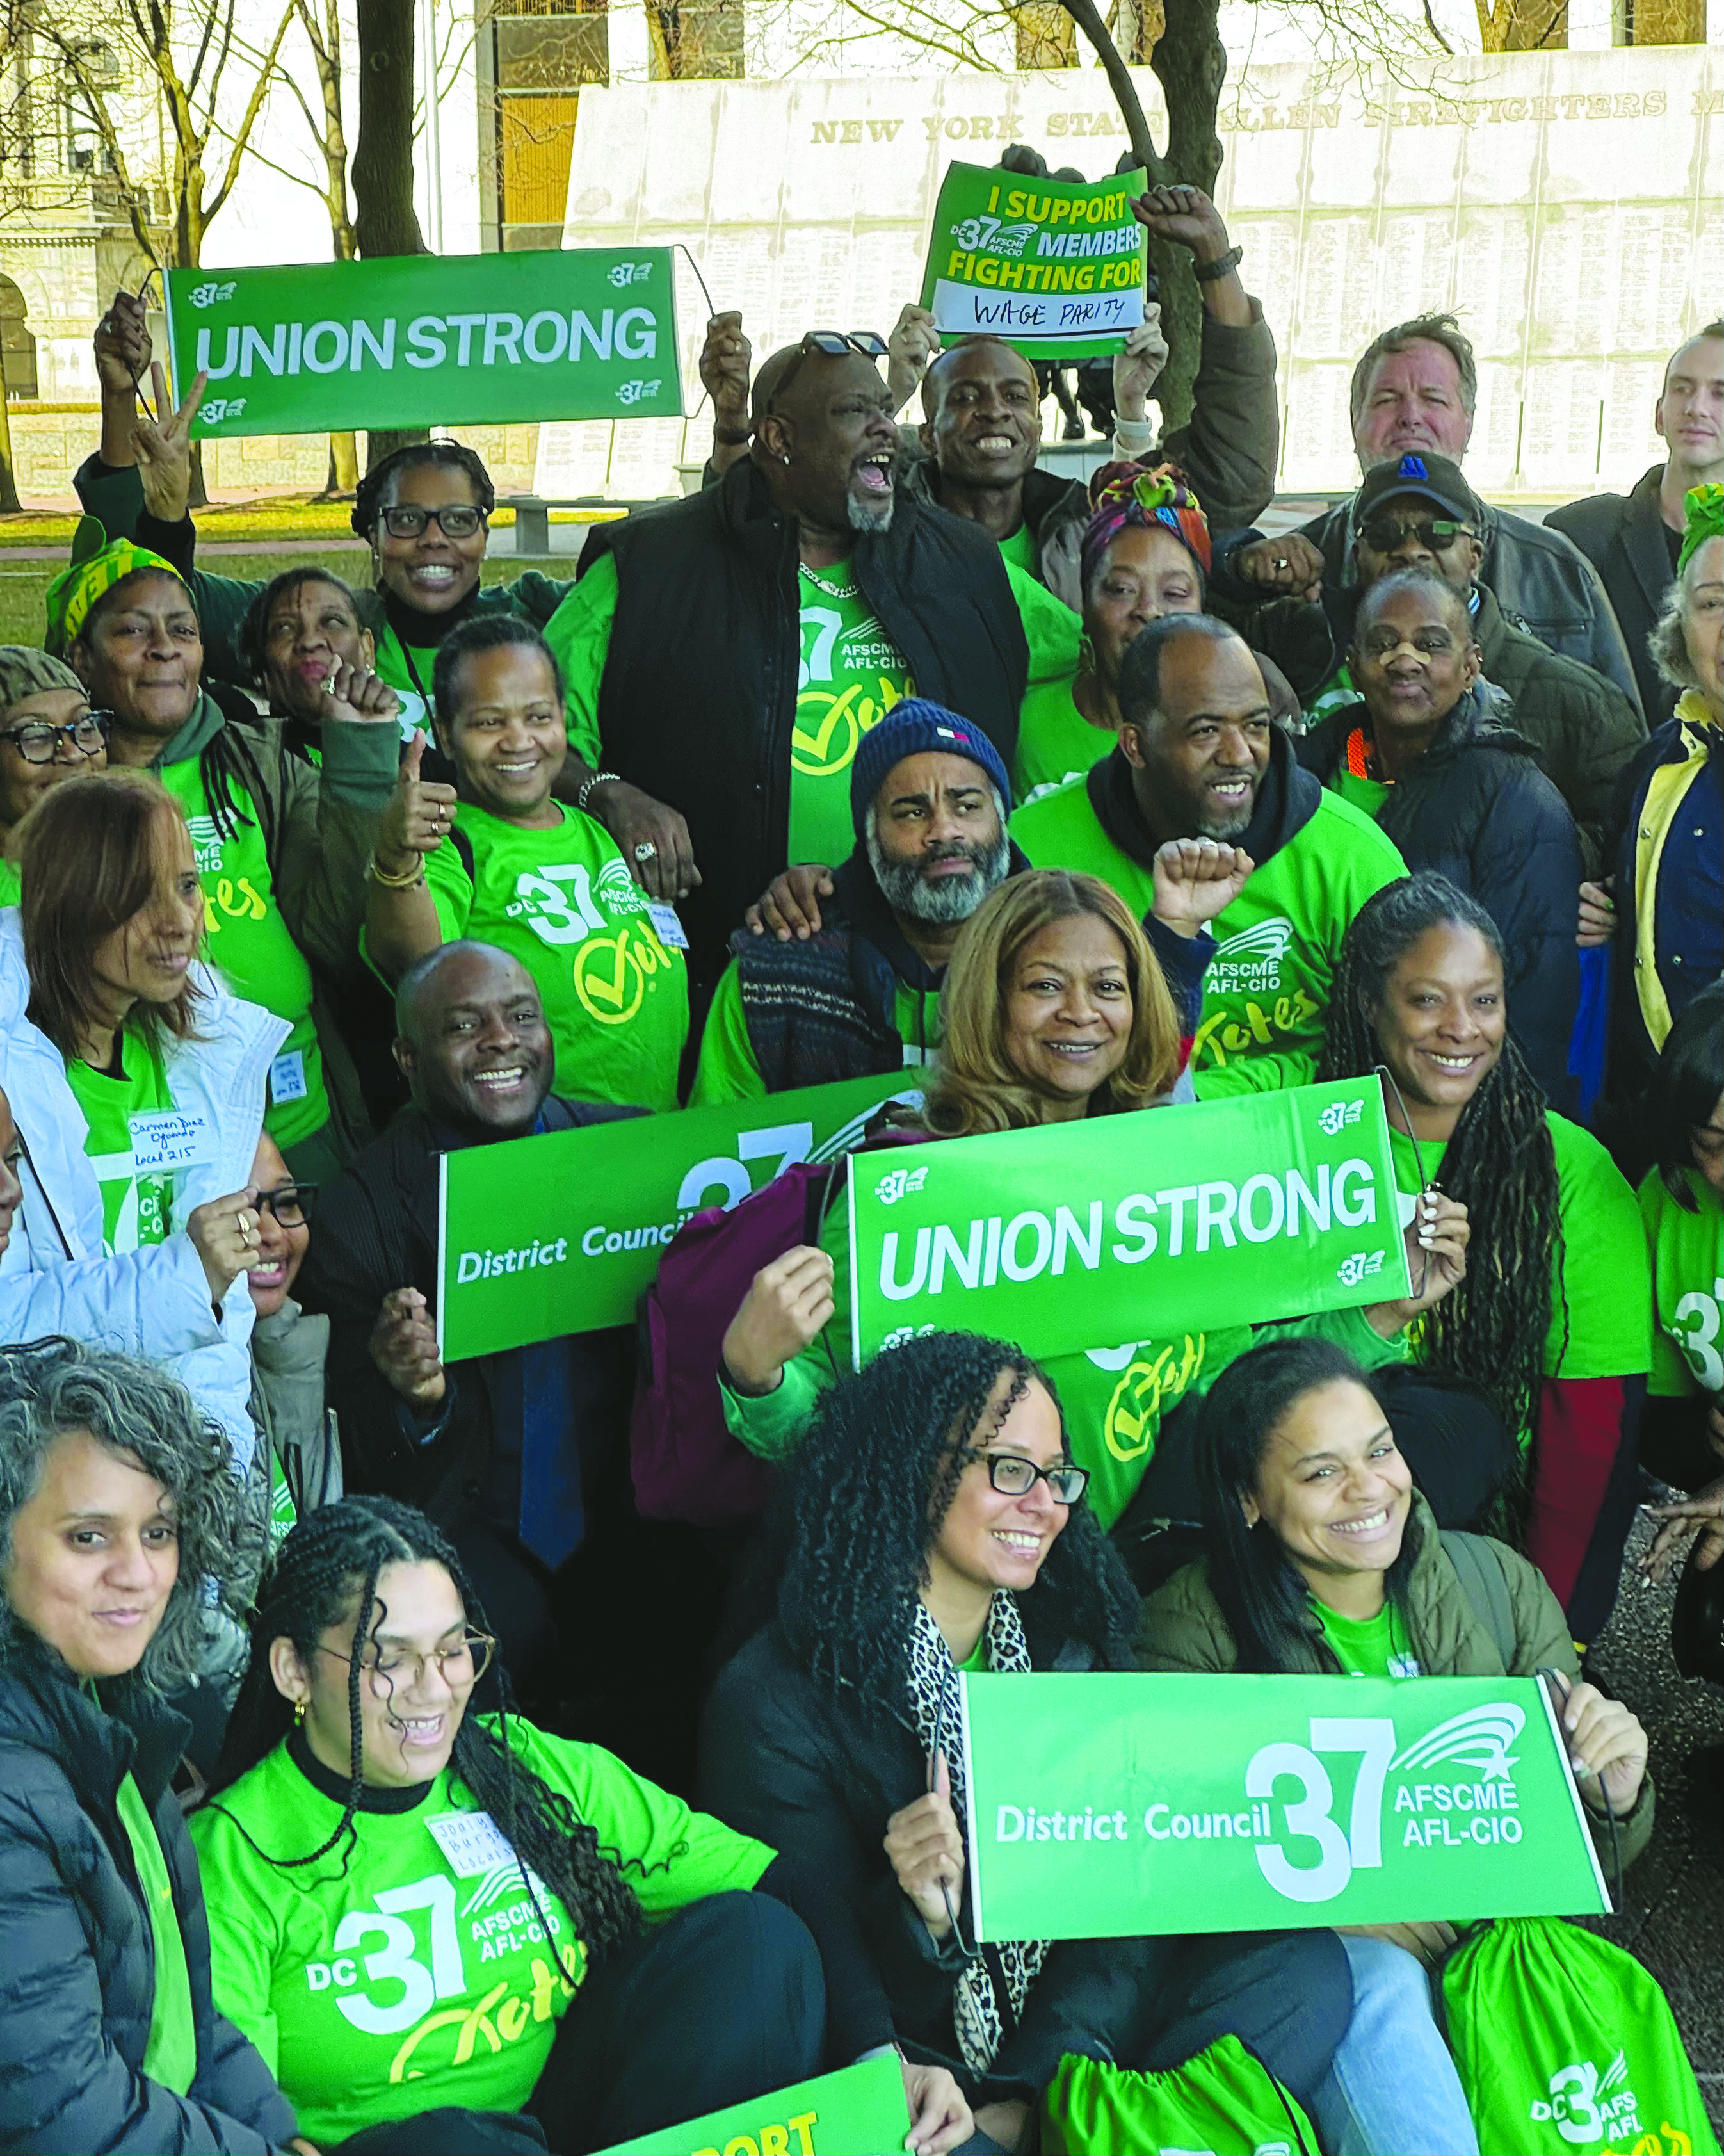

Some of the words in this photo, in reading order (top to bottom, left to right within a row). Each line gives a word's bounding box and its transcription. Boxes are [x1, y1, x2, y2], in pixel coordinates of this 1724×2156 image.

[811, 120, 904, 144] NEW
[922, 114, 1024, 140] YORK
[1364, 90, 1667, 127] FIREFIGHTERS
[988, 186, 1000, 214] I
[1005, 191, 1126, 225] SUPPORT
[1036, 222, 1141, 257] MEMBERS
[947, 250, 1095, 291] FIGHTING
[1099, 258, 1141, 288] FOR
[974, 295, 1047, 325] WAGE
[1059, 298, 1125, 326] PARITY
[798, 606, 843, 690] 7
[842, 642, 898, 656] AFSCM
[517, 864, 609, 945] 37
[1205, 961, 1279, 977] AFSCME
[1207, 977, 1281, 994] AFL-CIO
[129, 1121, 178, 1135] Carmen
[167, 1146, 196, 1160] 215
[458, 1236, 568, 1285] District
[582, 1212, 693, 1256] Counc
[995, 1804, 1128, 1842] District
[1145, 1802, 1271, 1840] Council
[1245, 1717, 1398, 1903] 37
[1394, 1781, 1519, 1813] AFSCME
[1403, 1816, 1524, 1847] AFL-CIO
[471, 1893, 552, 1941] AFSCME
[306, 1958, 358, 1991] DC
[334, 1874, 467, 2035] 37
[481, 1915, 560, 1963] AFL-CIO
[1530, 2094, 1566, 2121] DC
